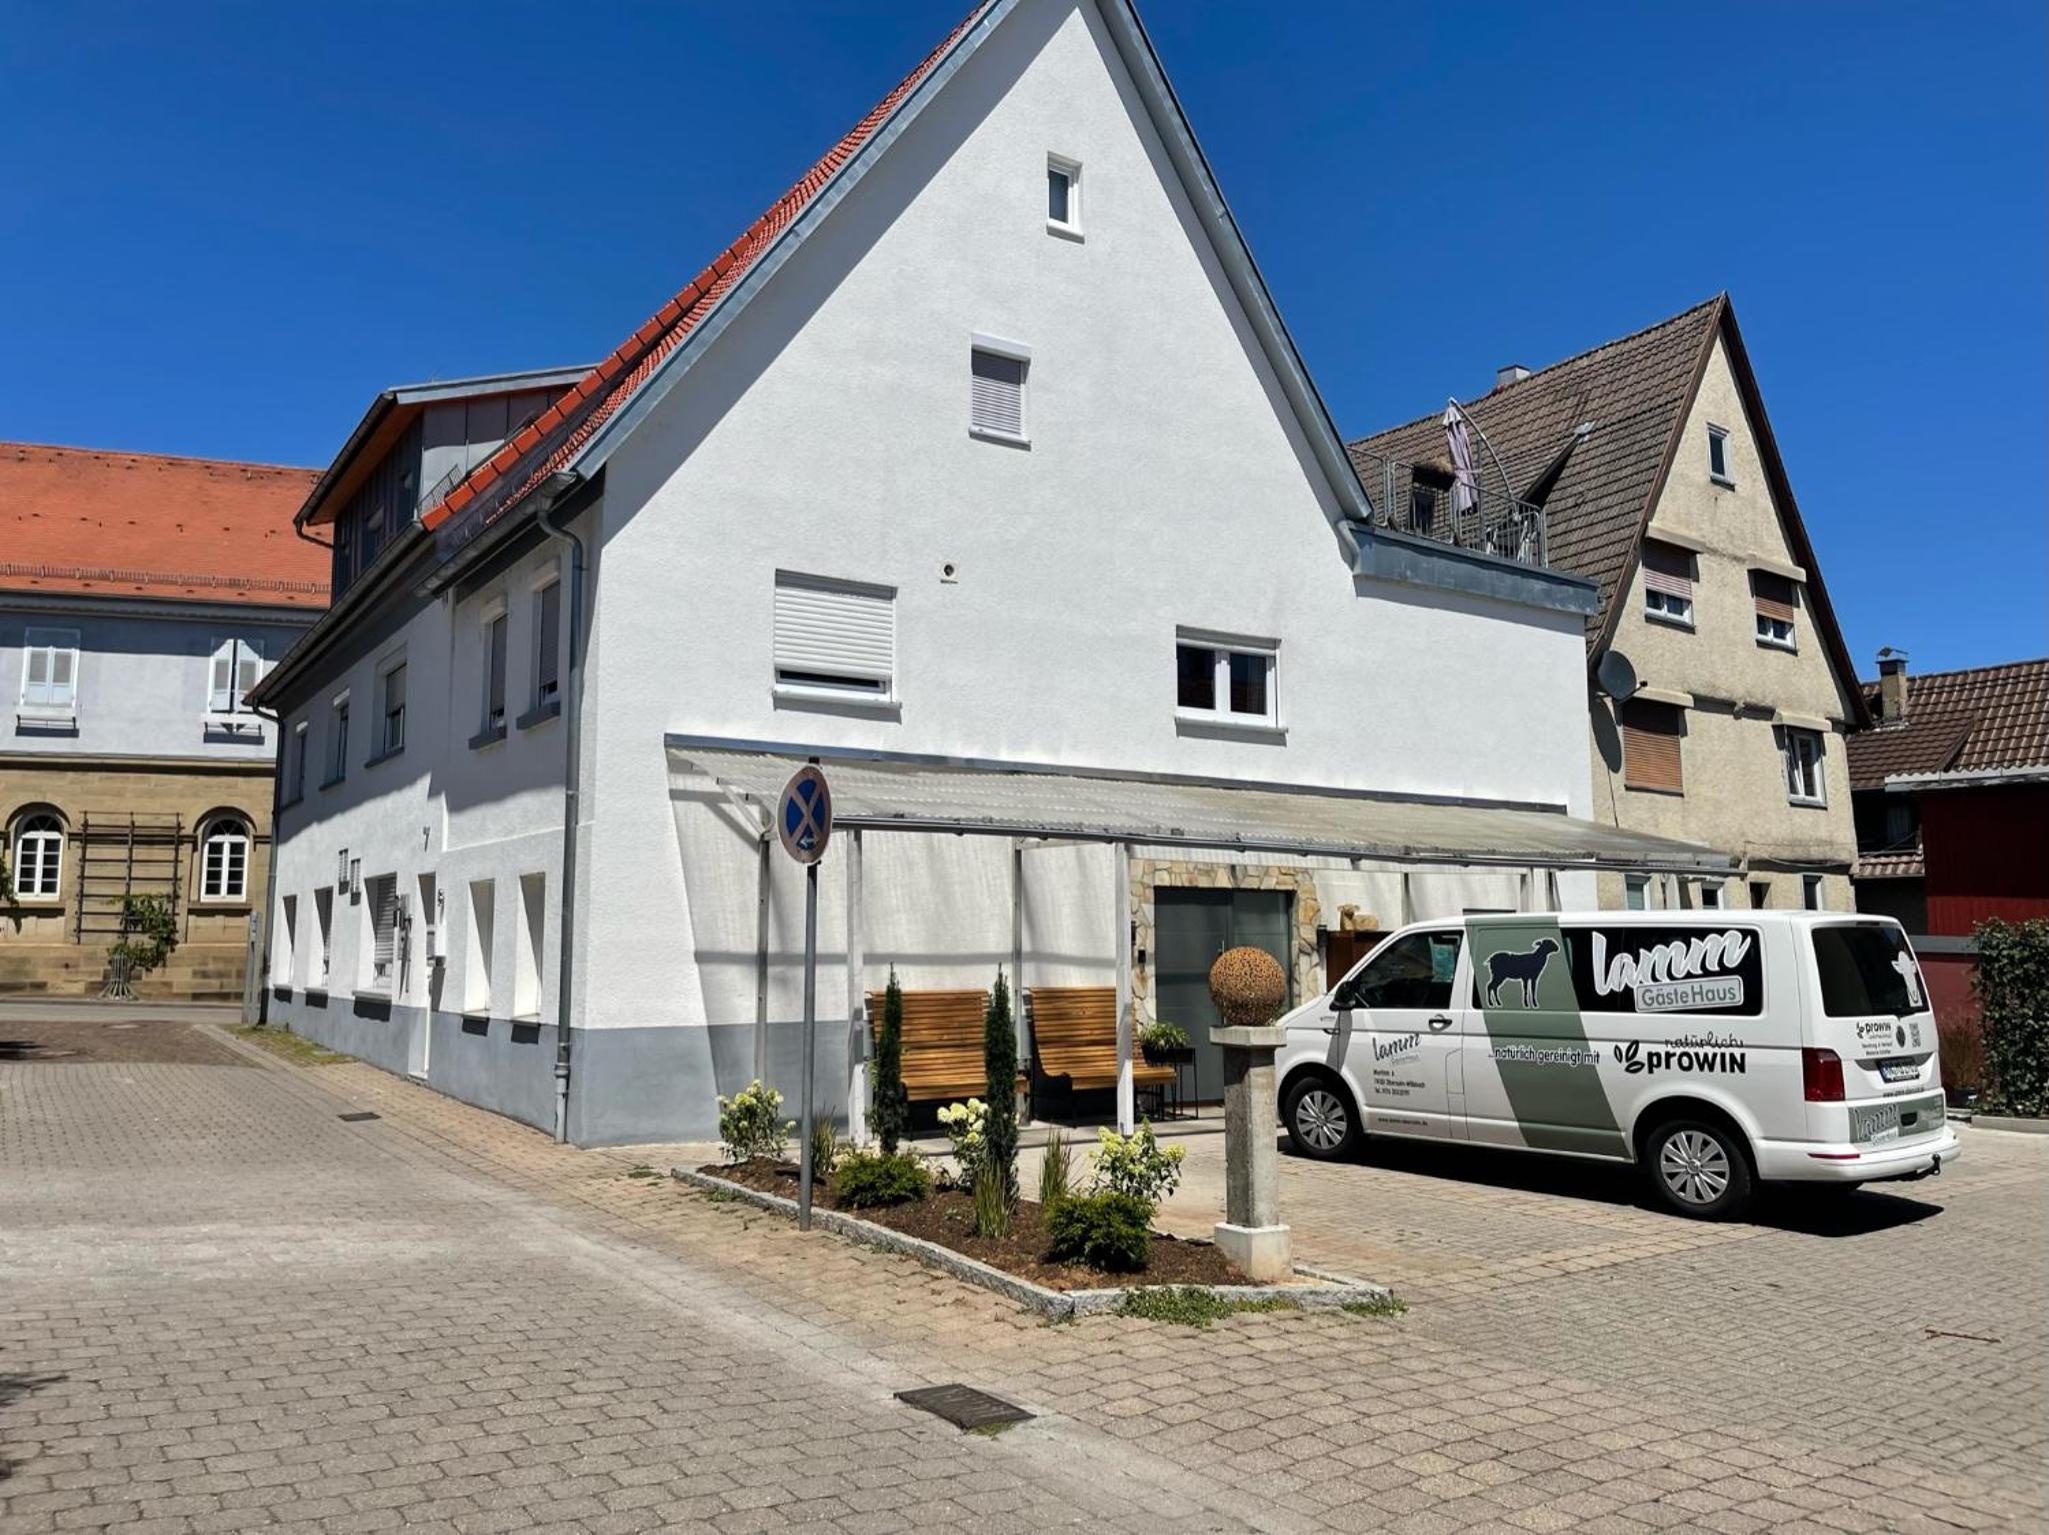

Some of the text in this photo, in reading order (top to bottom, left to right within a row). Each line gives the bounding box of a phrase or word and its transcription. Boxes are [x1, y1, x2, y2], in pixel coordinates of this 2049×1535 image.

[1592, 930, 1751, 995] lamm
[1373, 1033, 1421, 1061] lamm
[1538, 1048, 1581, 1066] gereinigt
[1584, 1050, 1600, 1064] mit
[1648, 1051, 1746, 1074] proWIN
